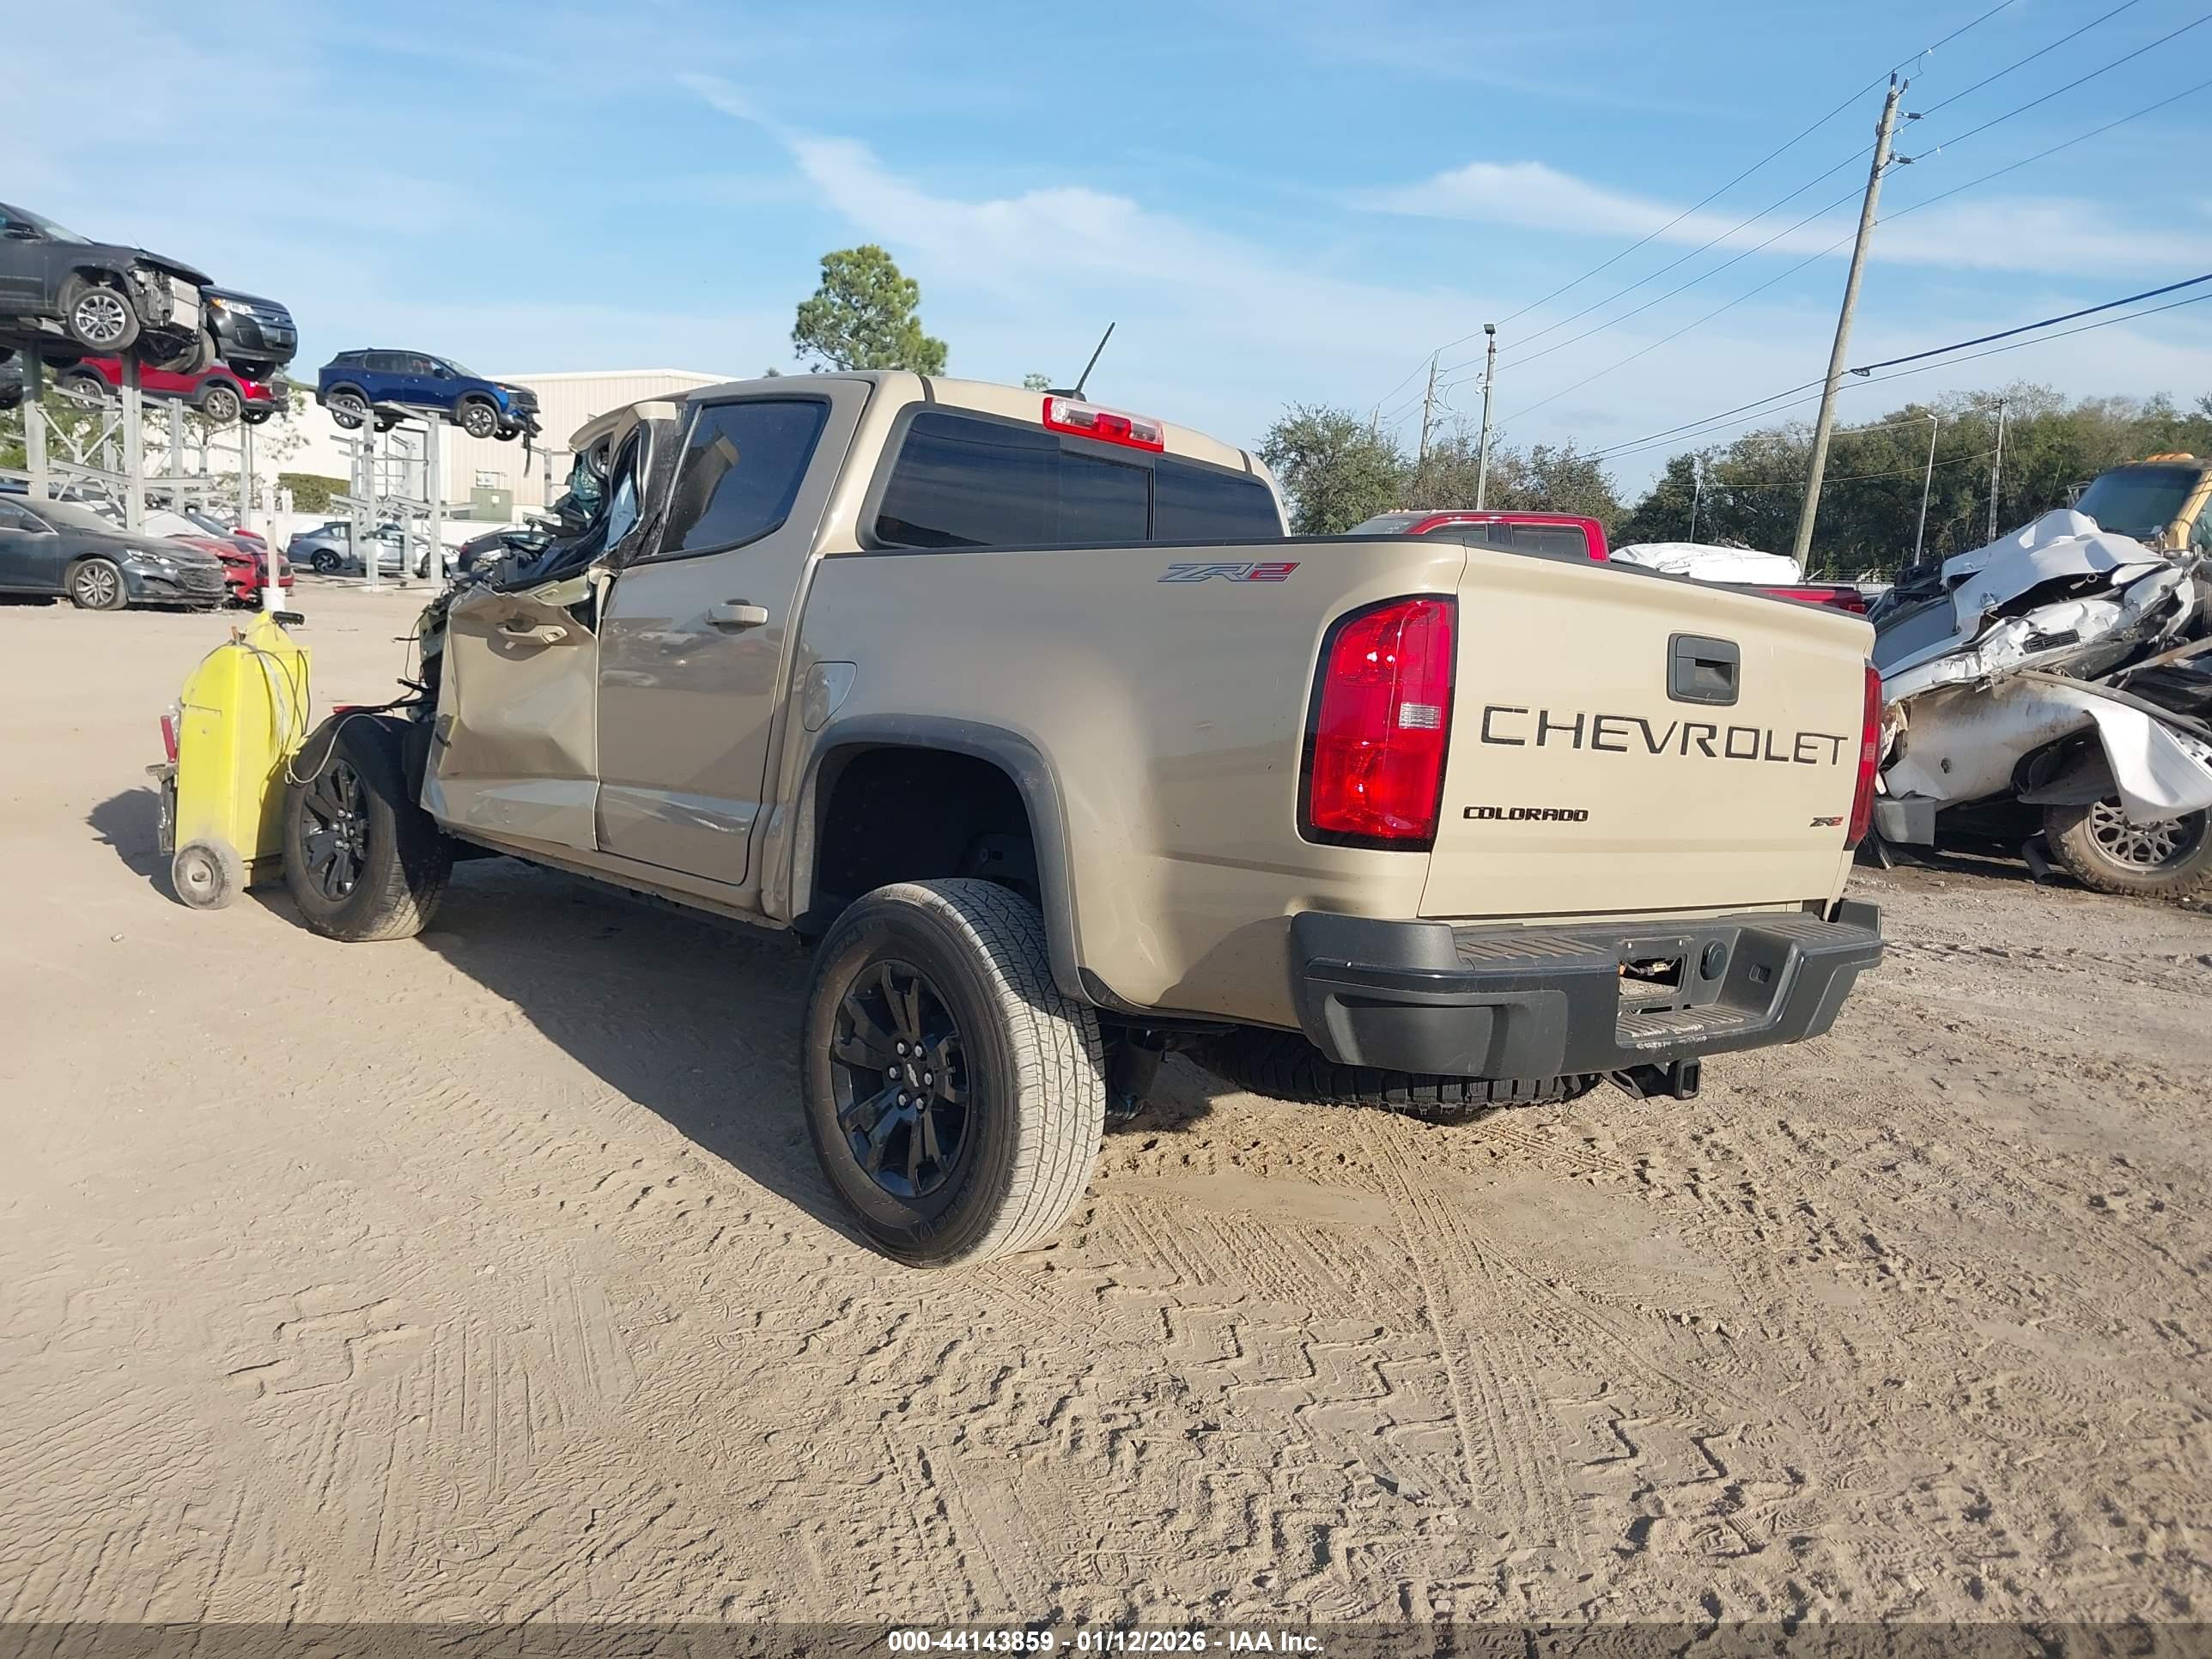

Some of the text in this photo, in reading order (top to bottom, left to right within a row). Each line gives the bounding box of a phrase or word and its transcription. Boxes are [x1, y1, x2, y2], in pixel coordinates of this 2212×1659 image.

[1158, 562, 1301, 582] ZR2
[1480, 705, 1849, 765] CHEVROLET
[1462, 806, 1589, 822] COLORADO
[1809, 817, 1844, 827] ZR2
